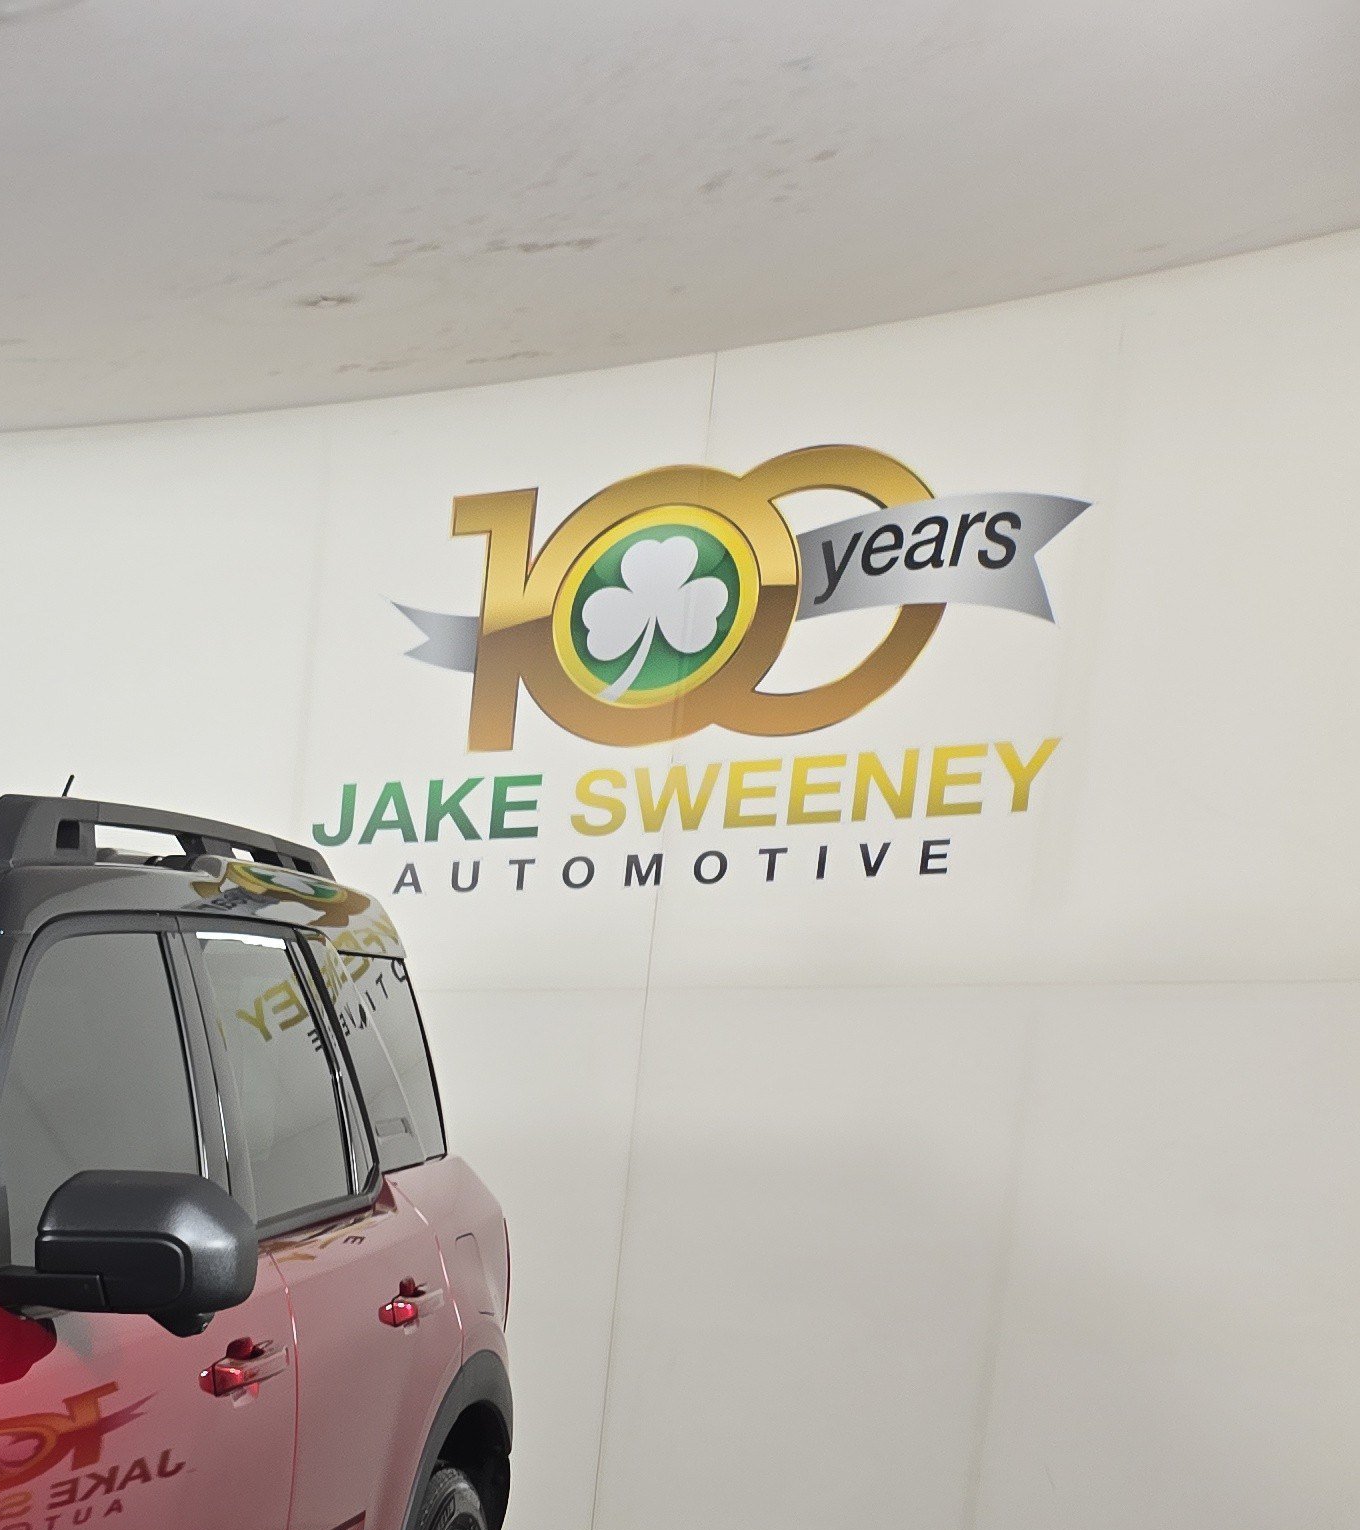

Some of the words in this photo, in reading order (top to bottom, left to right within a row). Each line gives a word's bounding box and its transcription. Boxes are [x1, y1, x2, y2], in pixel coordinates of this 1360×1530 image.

[813, 508, 1023, 606] years
[311, 773, 543, 848] JAKE
[568, 736, 1063, 838] SWEENEY
[391, 838, 952, 897] AUTOMOTIVE
